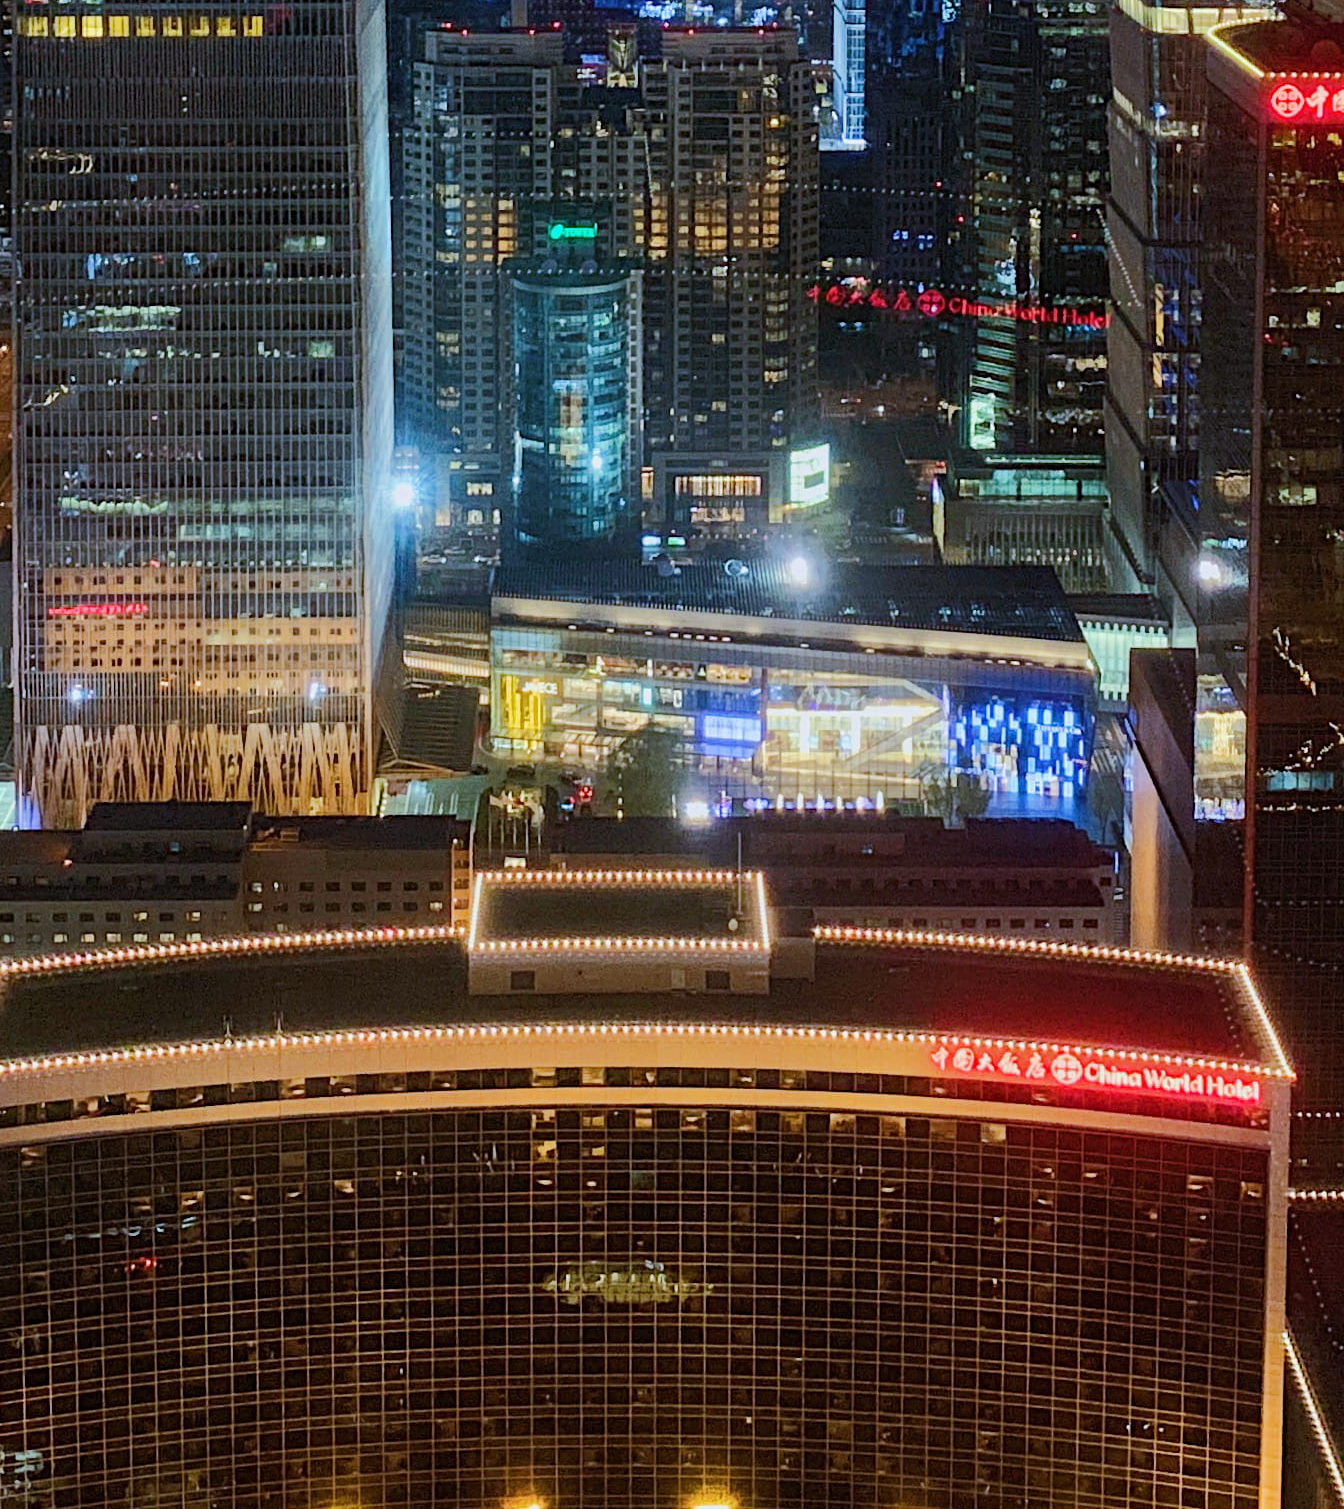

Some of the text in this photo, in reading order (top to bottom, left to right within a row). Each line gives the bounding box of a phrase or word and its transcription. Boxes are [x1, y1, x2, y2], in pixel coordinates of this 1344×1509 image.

[1085, 1063, 1142, 1088] China
[1142, 1068, 1203, 1095] World
[1206, 1076, 1259, 1101] Hotel
